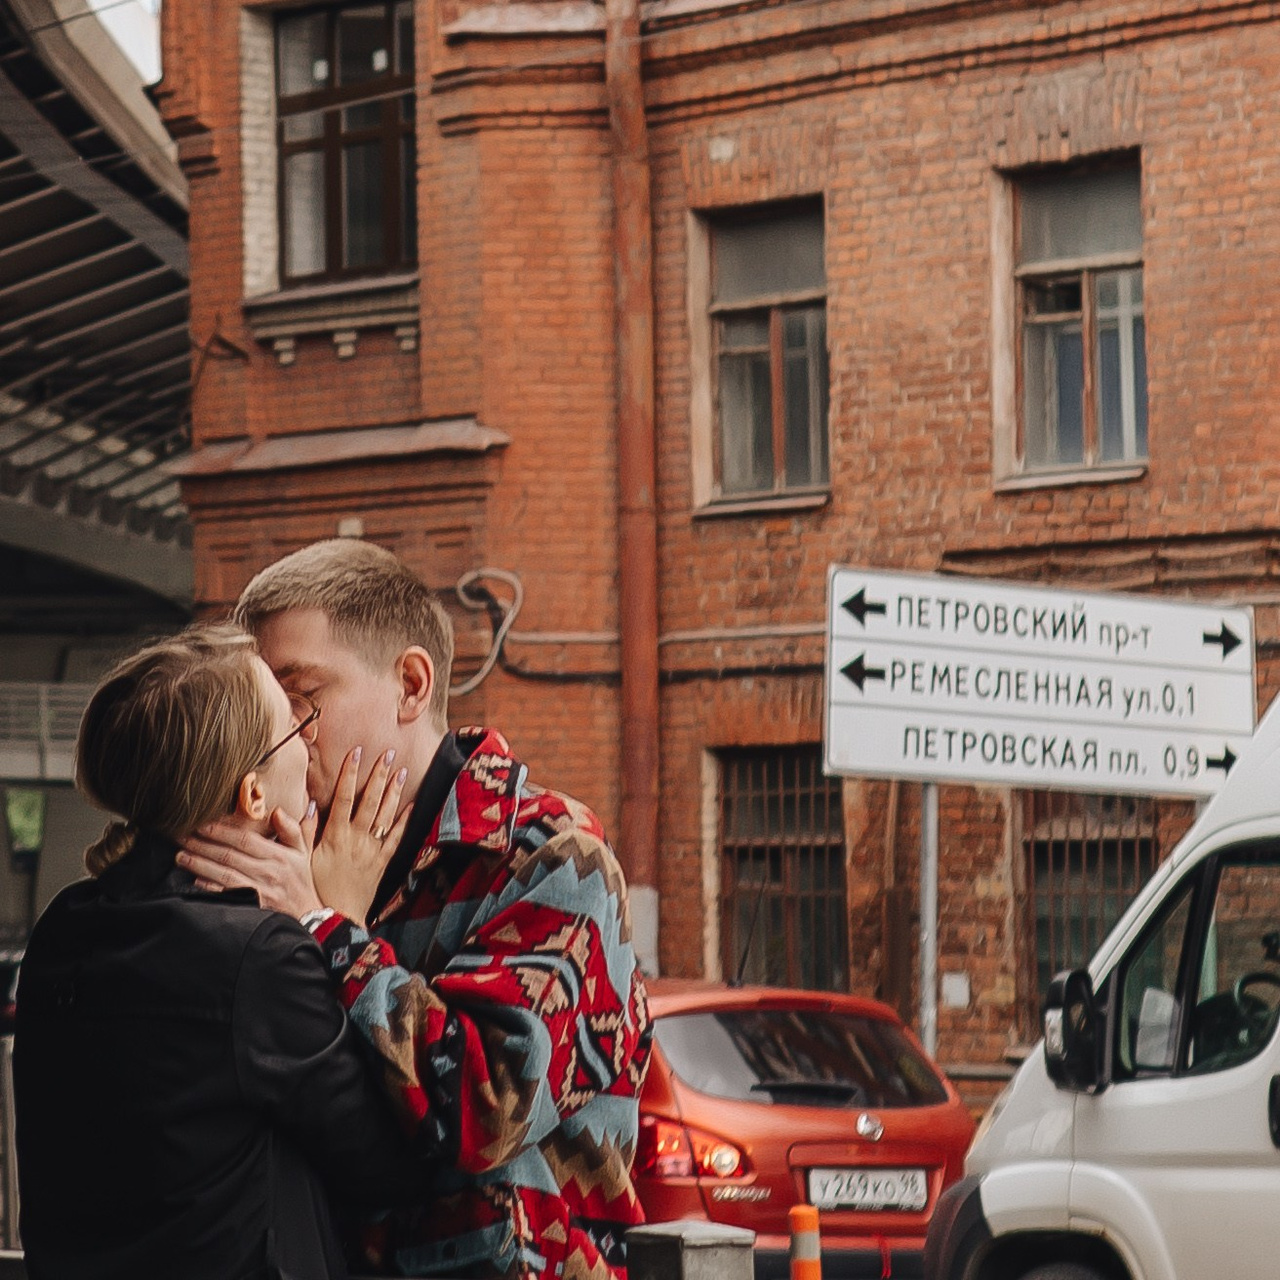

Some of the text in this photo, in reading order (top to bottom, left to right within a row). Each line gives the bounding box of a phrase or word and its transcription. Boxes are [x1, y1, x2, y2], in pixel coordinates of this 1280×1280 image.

[896, 595, 1152, 655] ПЕТРОВСКИЙ пр-т
[890, 659, 1113, 710] РЕМЕСЛЕННАЯ
[903, 725, 1098, 769] ПЕТРОВСКАЯ
[1108, 748, 1148, 776] пл.
